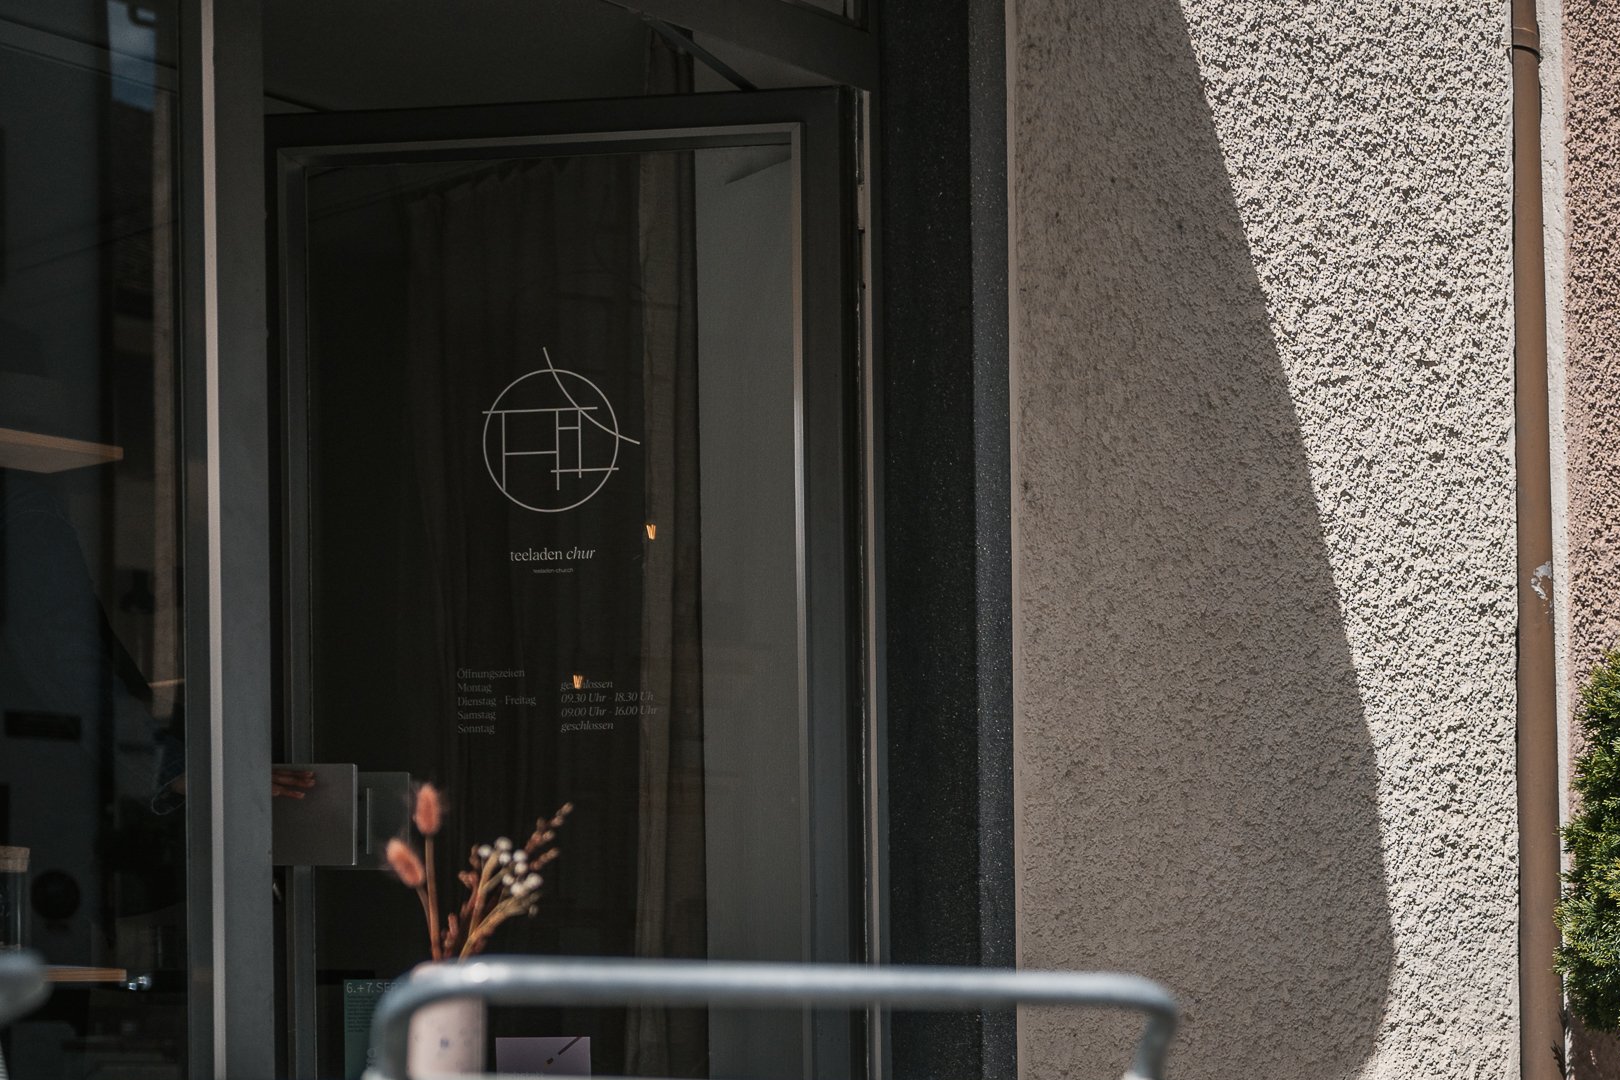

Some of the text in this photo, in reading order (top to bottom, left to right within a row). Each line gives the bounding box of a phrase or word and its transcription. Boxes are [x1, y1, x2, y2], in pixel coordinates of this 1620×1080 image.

[510, 546, 597, 562] teeladen chur
[456, 667, 525, 681] Öffnungszeiten
[457, 683, 492, 694] Montag
[457, 696, 497, 707] Dienstag
[505, 695, 537, 707] Freitag
[560, 693, 587, 703] 09.30
[588, 692, 607, 703] Uhr
[614, 691, 638, 703] 18.30
[457, 710, 497, 721] Samstag
[560, 707, 587, 717] 09.00
[588, 705, 607, 716] Uhr
[614, 705, 638, 717] 16.00
[640, 704, 658, 715] Uhr
[457, 720, 614, 735] Sonntag geschlossen
